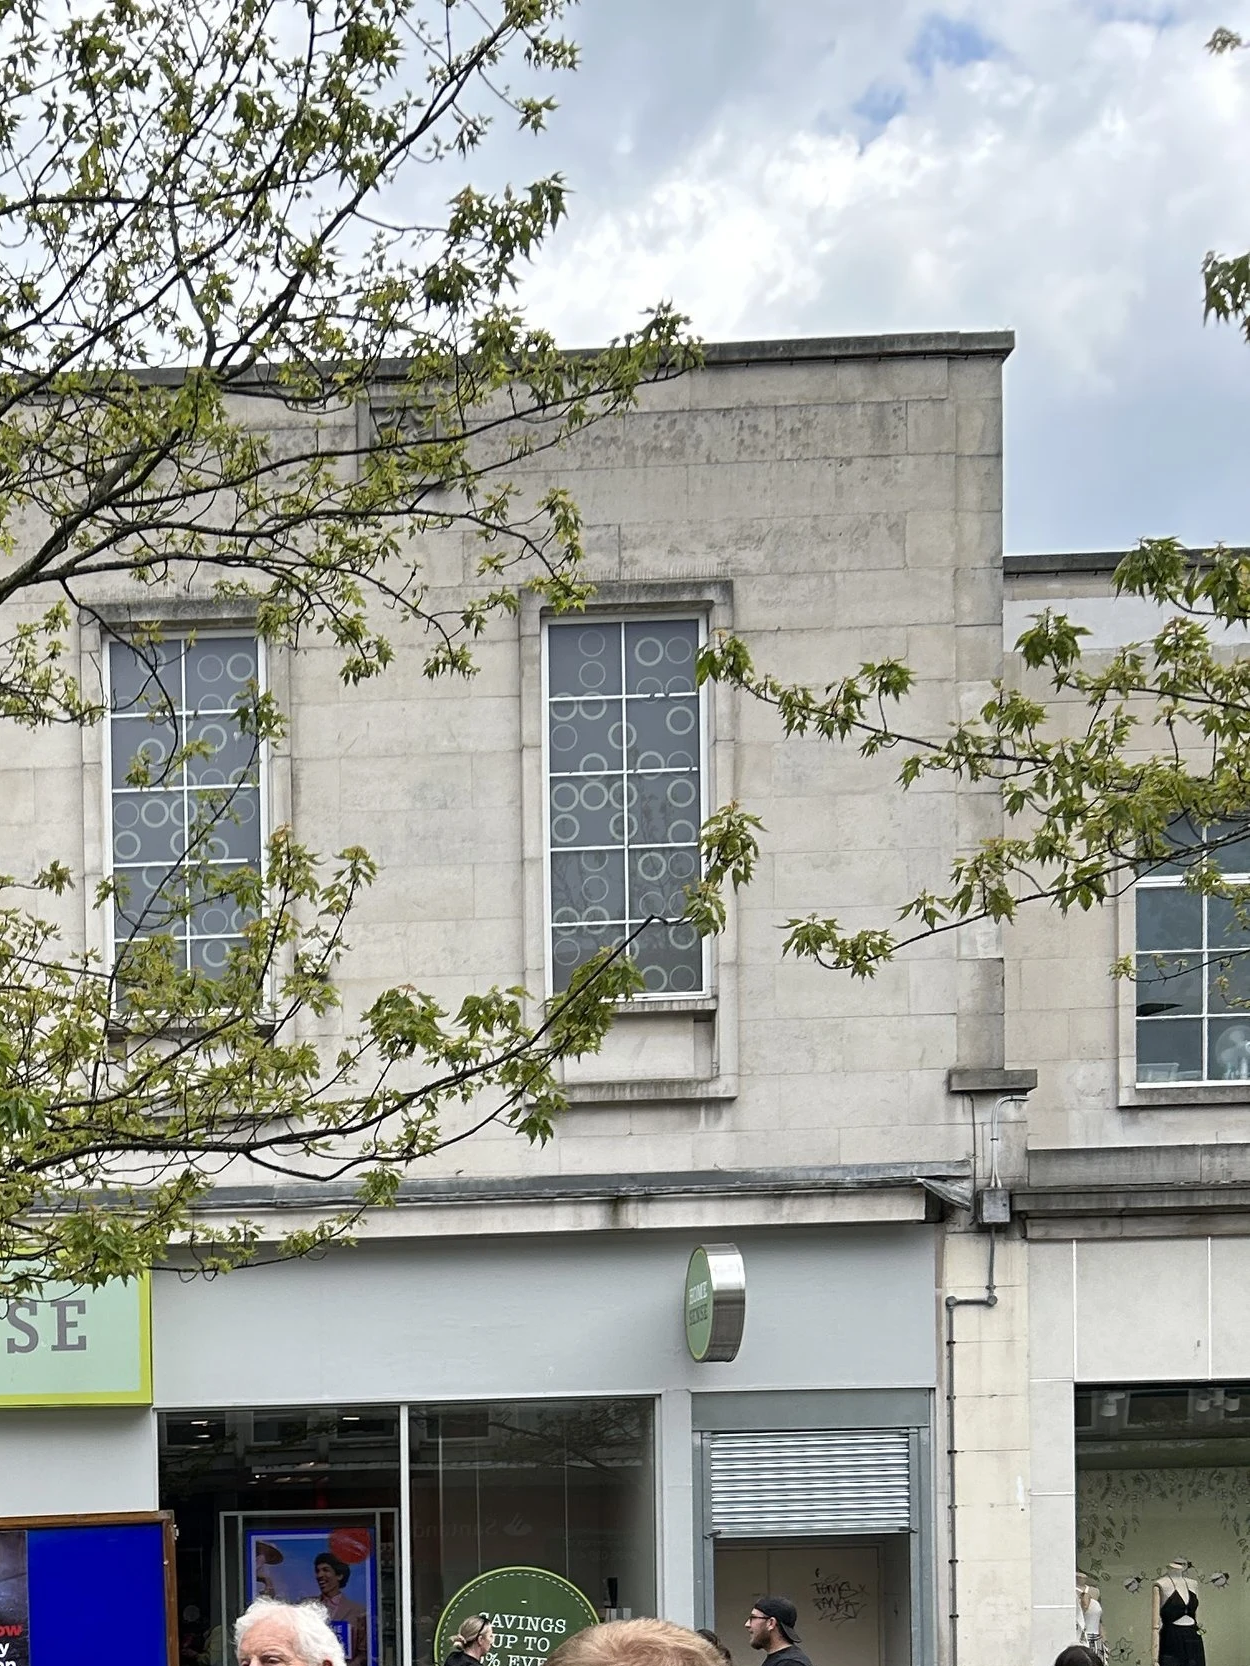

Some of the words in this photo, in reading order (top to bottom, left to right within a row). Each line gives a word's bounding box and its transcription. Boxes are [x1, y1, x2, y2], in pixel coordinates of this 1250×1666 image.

[478, 1612, 567, 1634] SAVINGS
[491, 1633, 518, 1649] UP
[523, 1637, 550, 1652] TO
